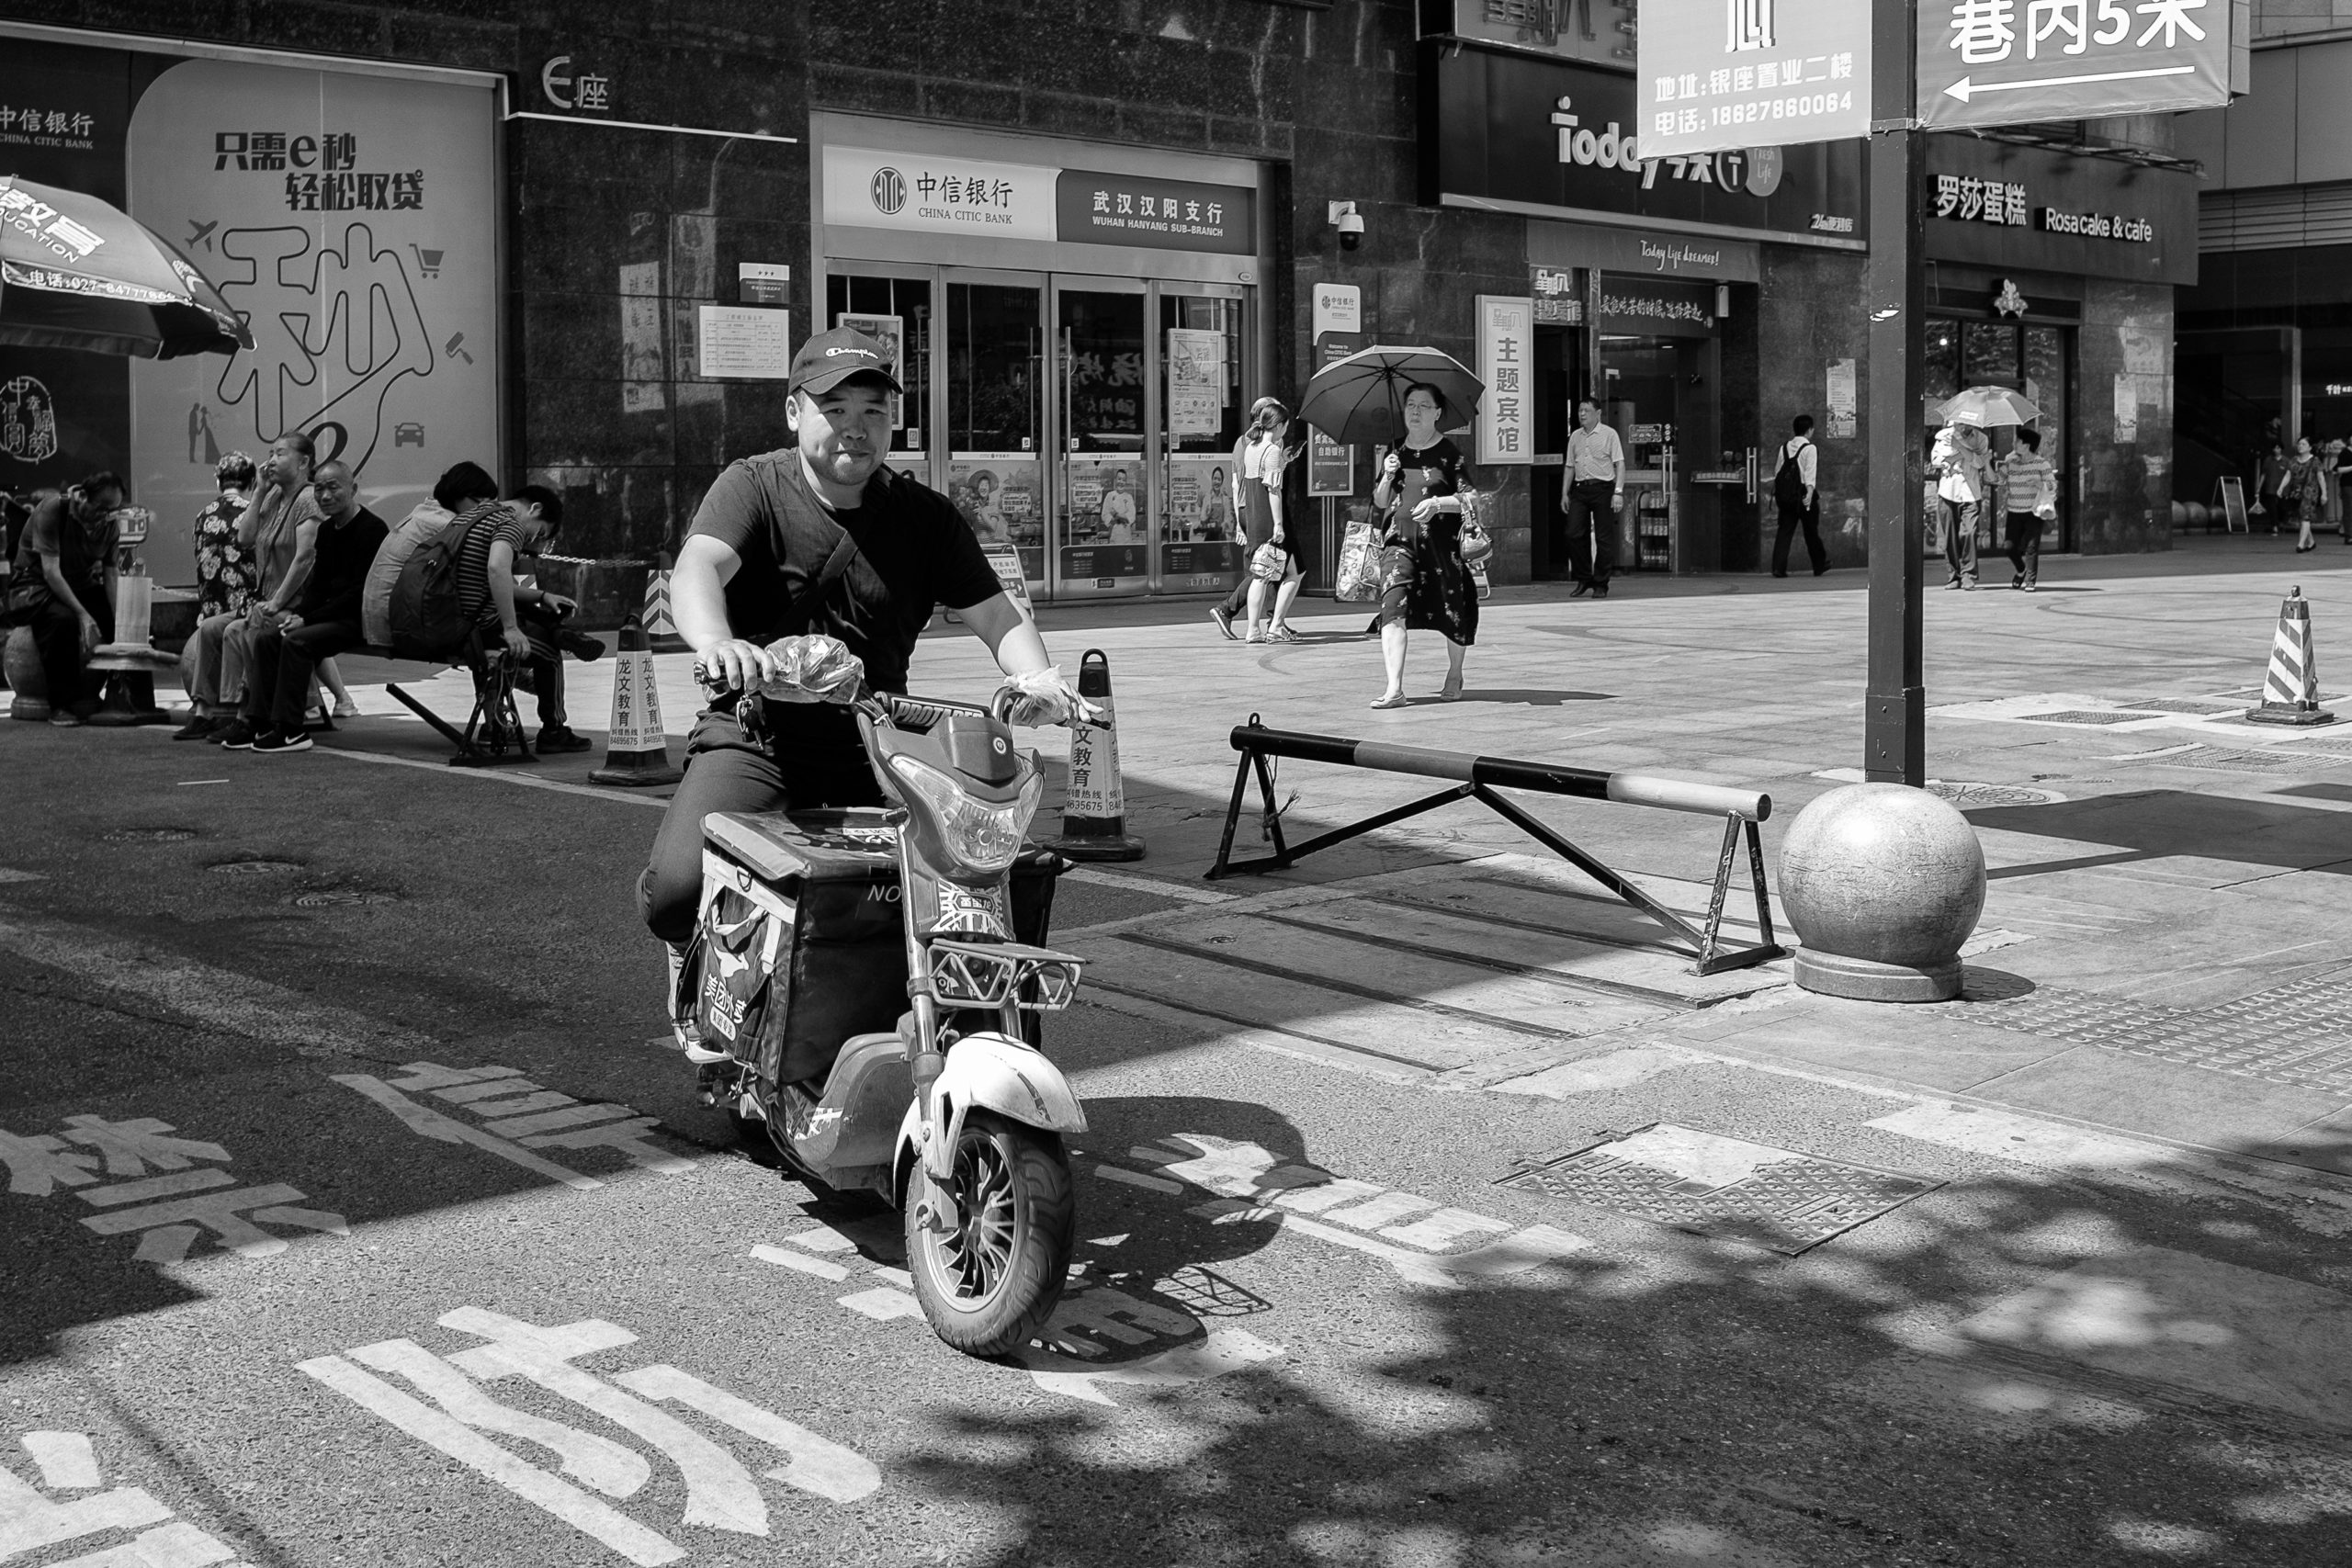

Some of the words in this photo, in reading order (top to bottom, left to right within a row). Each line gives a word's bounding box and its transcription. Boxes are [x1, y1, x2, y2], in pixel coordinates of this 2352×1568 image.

[0, 105, 95, 137] 中信银行
[34, 136, 62, 147] CITIC
[65, 138, 94, 150] BANK
[214, 132, 356, 171] 只需e秒
[285, 169, 424, 211] 轻松取贷
[917, 172, 1013, 209] 中信银行
[1092, 190, 1223, 225] 武汉汉阳支行
[1936, 175, 2028, 226] 罗莎蛋糕
[918, 207, 951, 220] CHINA
[955, 210, 982, 222] CITIC
[985, 213, 1013, 225] BANK
[1092, 216, 1125, 229] WUHAN
[1127, 219, 1168, 232] HANYANG
[1170, 223, 1224, 238] SUB-BRANCH
[1496, 337, 1520, 453] 主题宾馆
[617, 659, 631, 727] 龙文教育
[642, 657, 658, 725] 龙文教育
